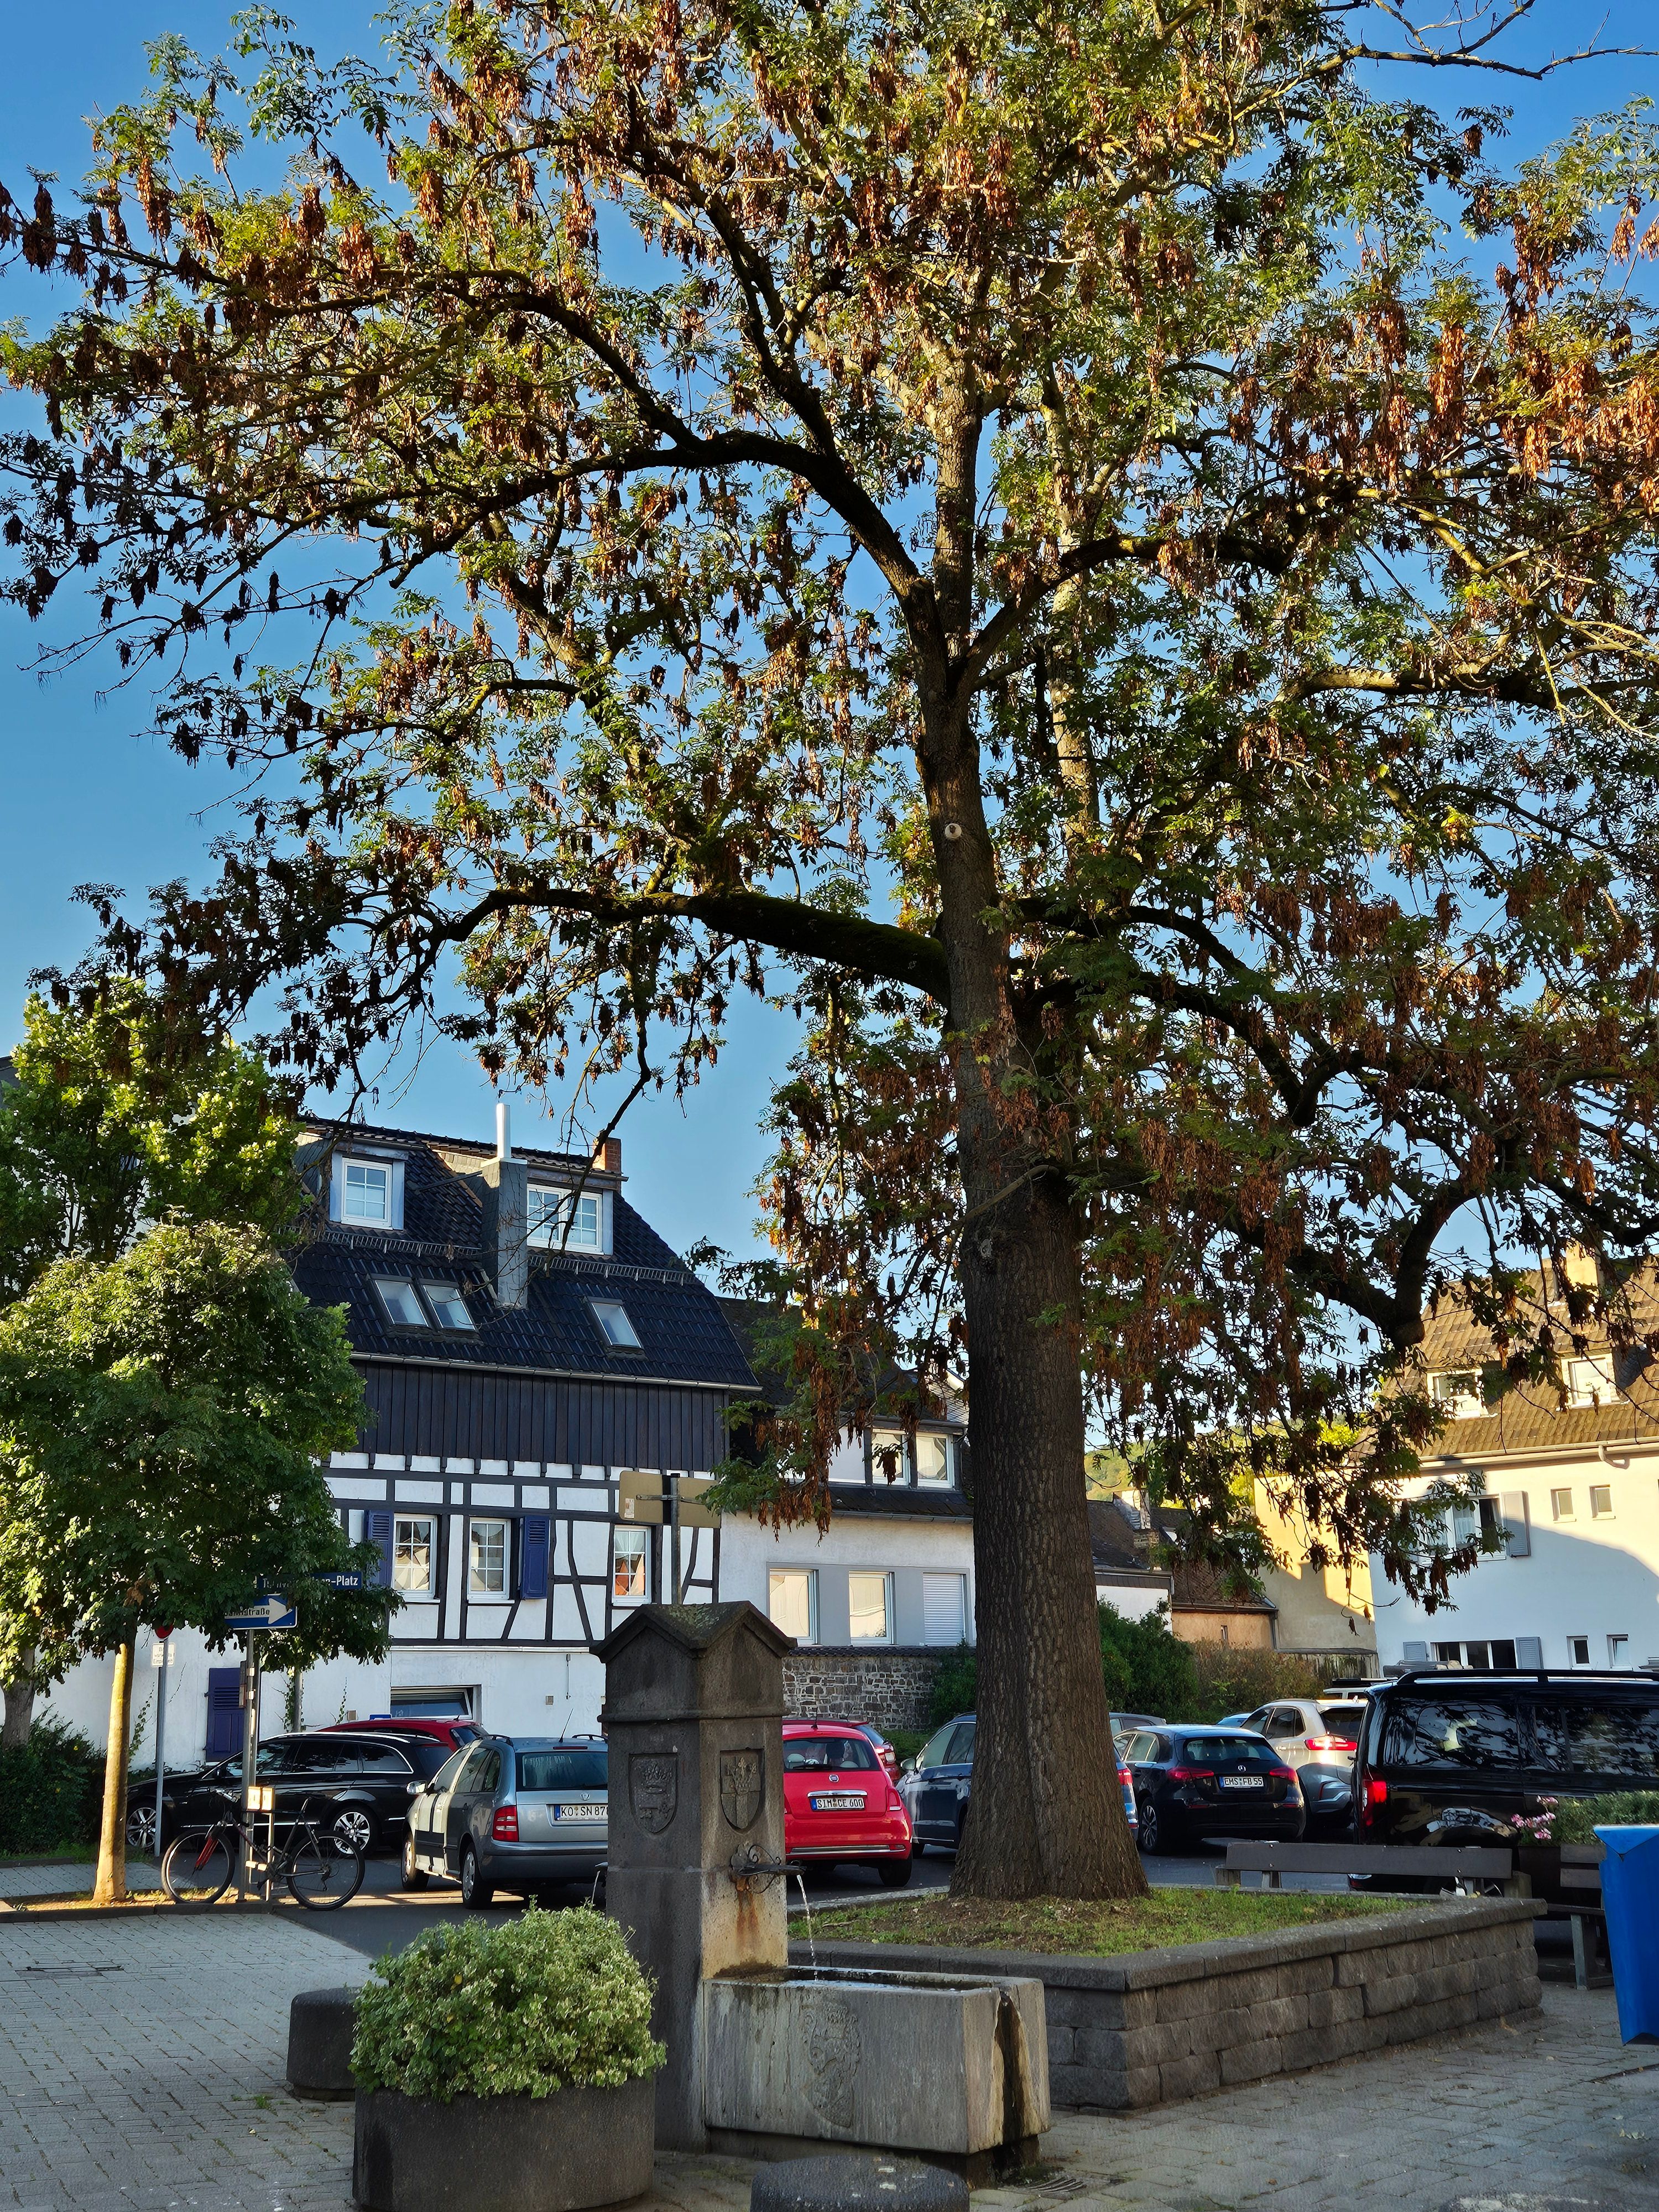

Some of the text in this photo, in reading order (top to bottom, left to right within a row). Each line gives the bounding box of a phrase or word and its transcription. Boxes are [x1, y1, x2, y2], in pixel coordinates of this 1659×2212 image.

[817, 1799, 863, 1808] SIM CE 600
[561, 1807, 573, 1817] KO
[581, 1806, 592, 1816] SN
